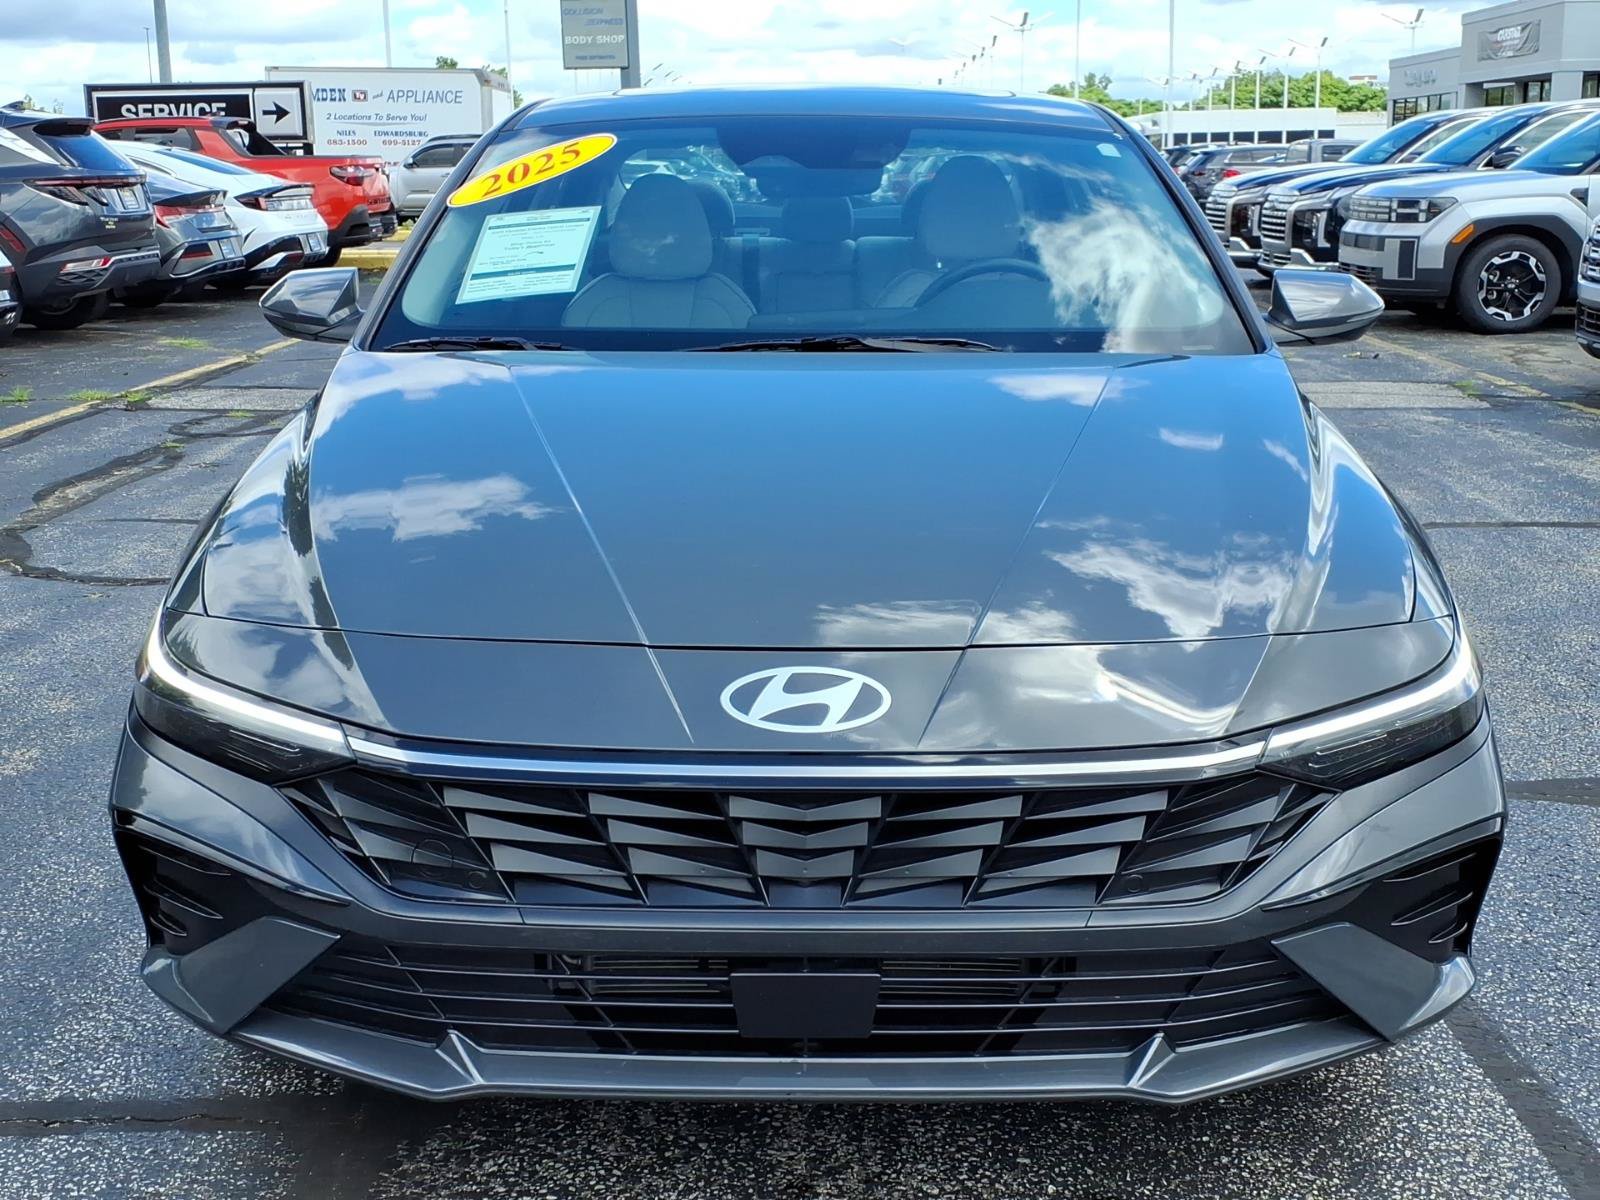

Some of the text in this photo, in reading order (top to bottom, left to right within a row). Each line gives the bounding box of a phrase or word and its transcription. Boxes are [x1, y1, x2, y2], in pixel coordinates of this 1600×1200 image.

[564, 34, 625, 45] BODY SHOP
[386, 89, 463, 104] APPLIANCE
[333, 113, 372, 121] Locations
[374, 113, 384, 121] To
[386, 114, 408, 122] Serve
[410, 114, 428, 122] You!
[373, 130, 429, 138] EDWARDSBURG
[480, 142, 581, 198] 2025
